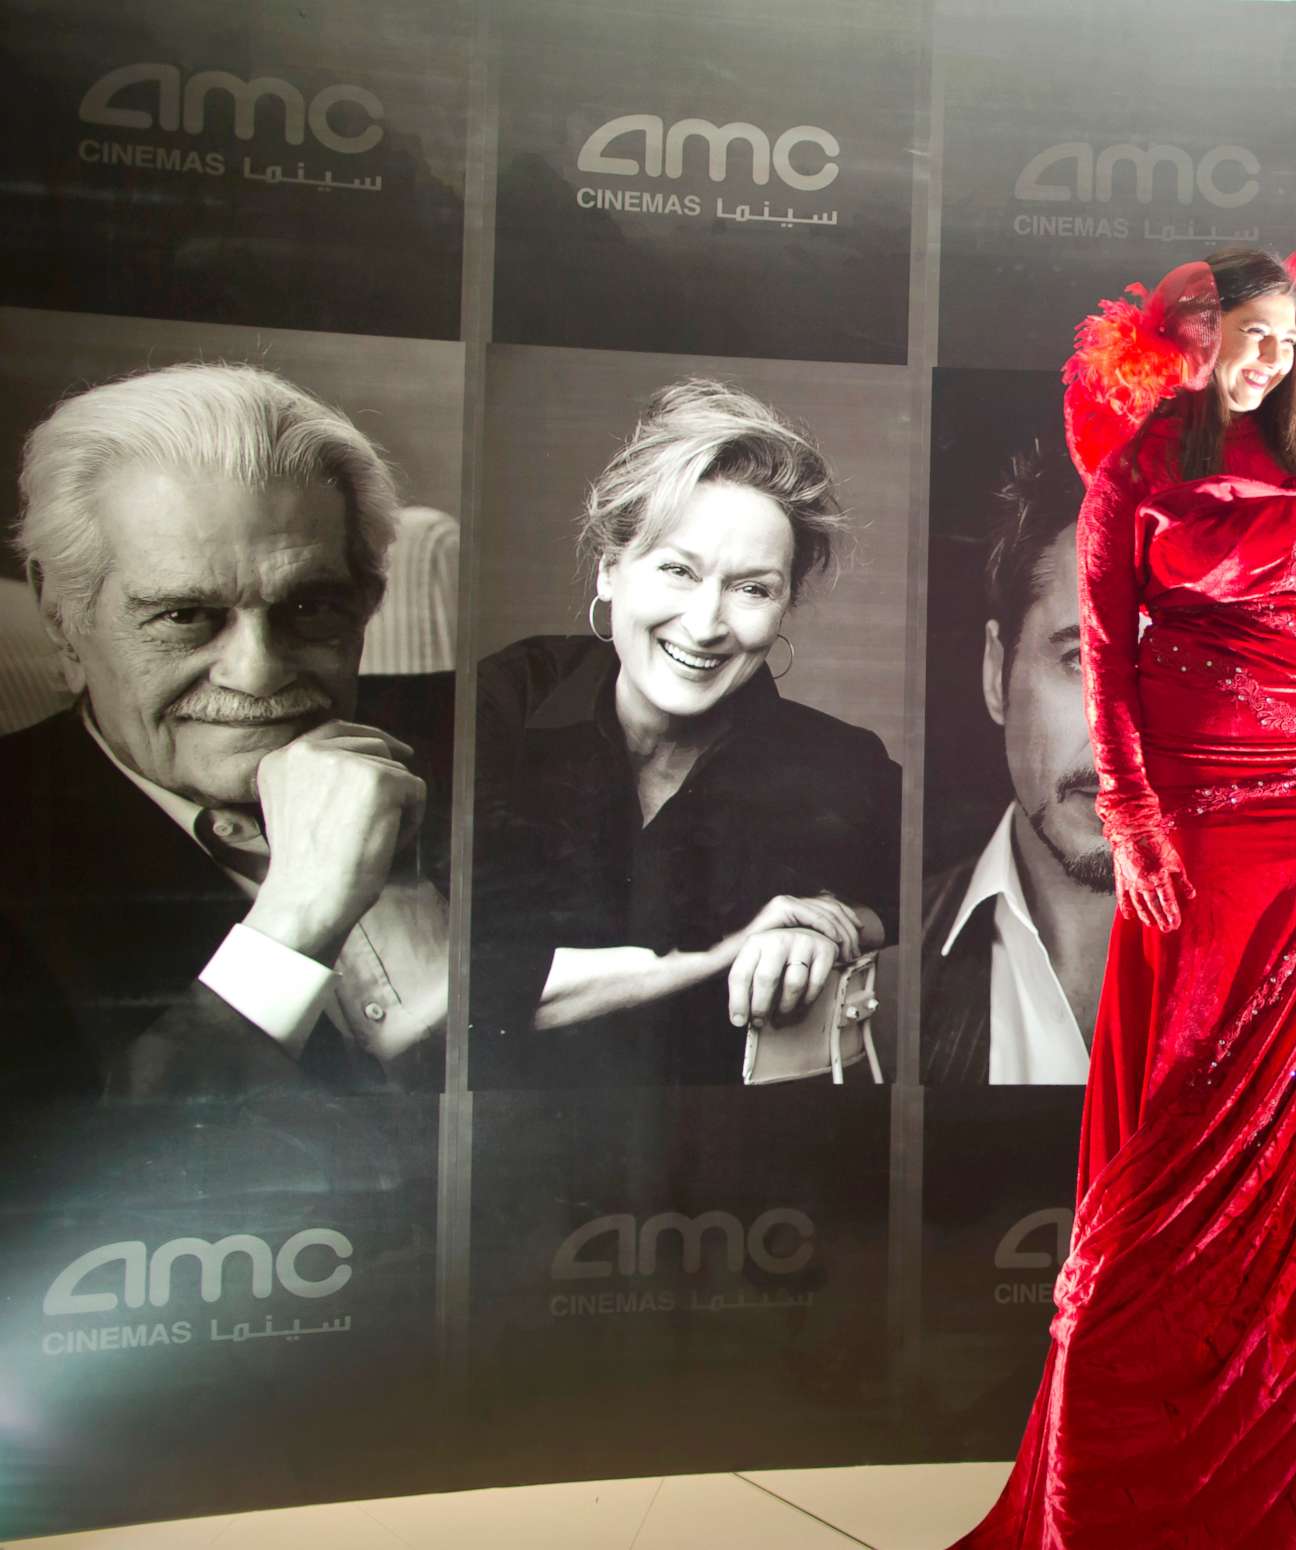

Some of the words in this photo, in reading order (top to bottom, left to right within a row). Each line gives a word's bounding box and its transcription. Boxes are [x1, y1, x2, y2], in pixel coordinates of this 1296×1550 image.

[78, 139, 225, 176] CINEMAS
[577, 187, 701, 216] CINEMAS
[1013, 215, 1128, 239] CINEMAS
[551, 1290, 676, 1317] CINEMAS
[42, 1321, 192, 1355] CINEMAS
